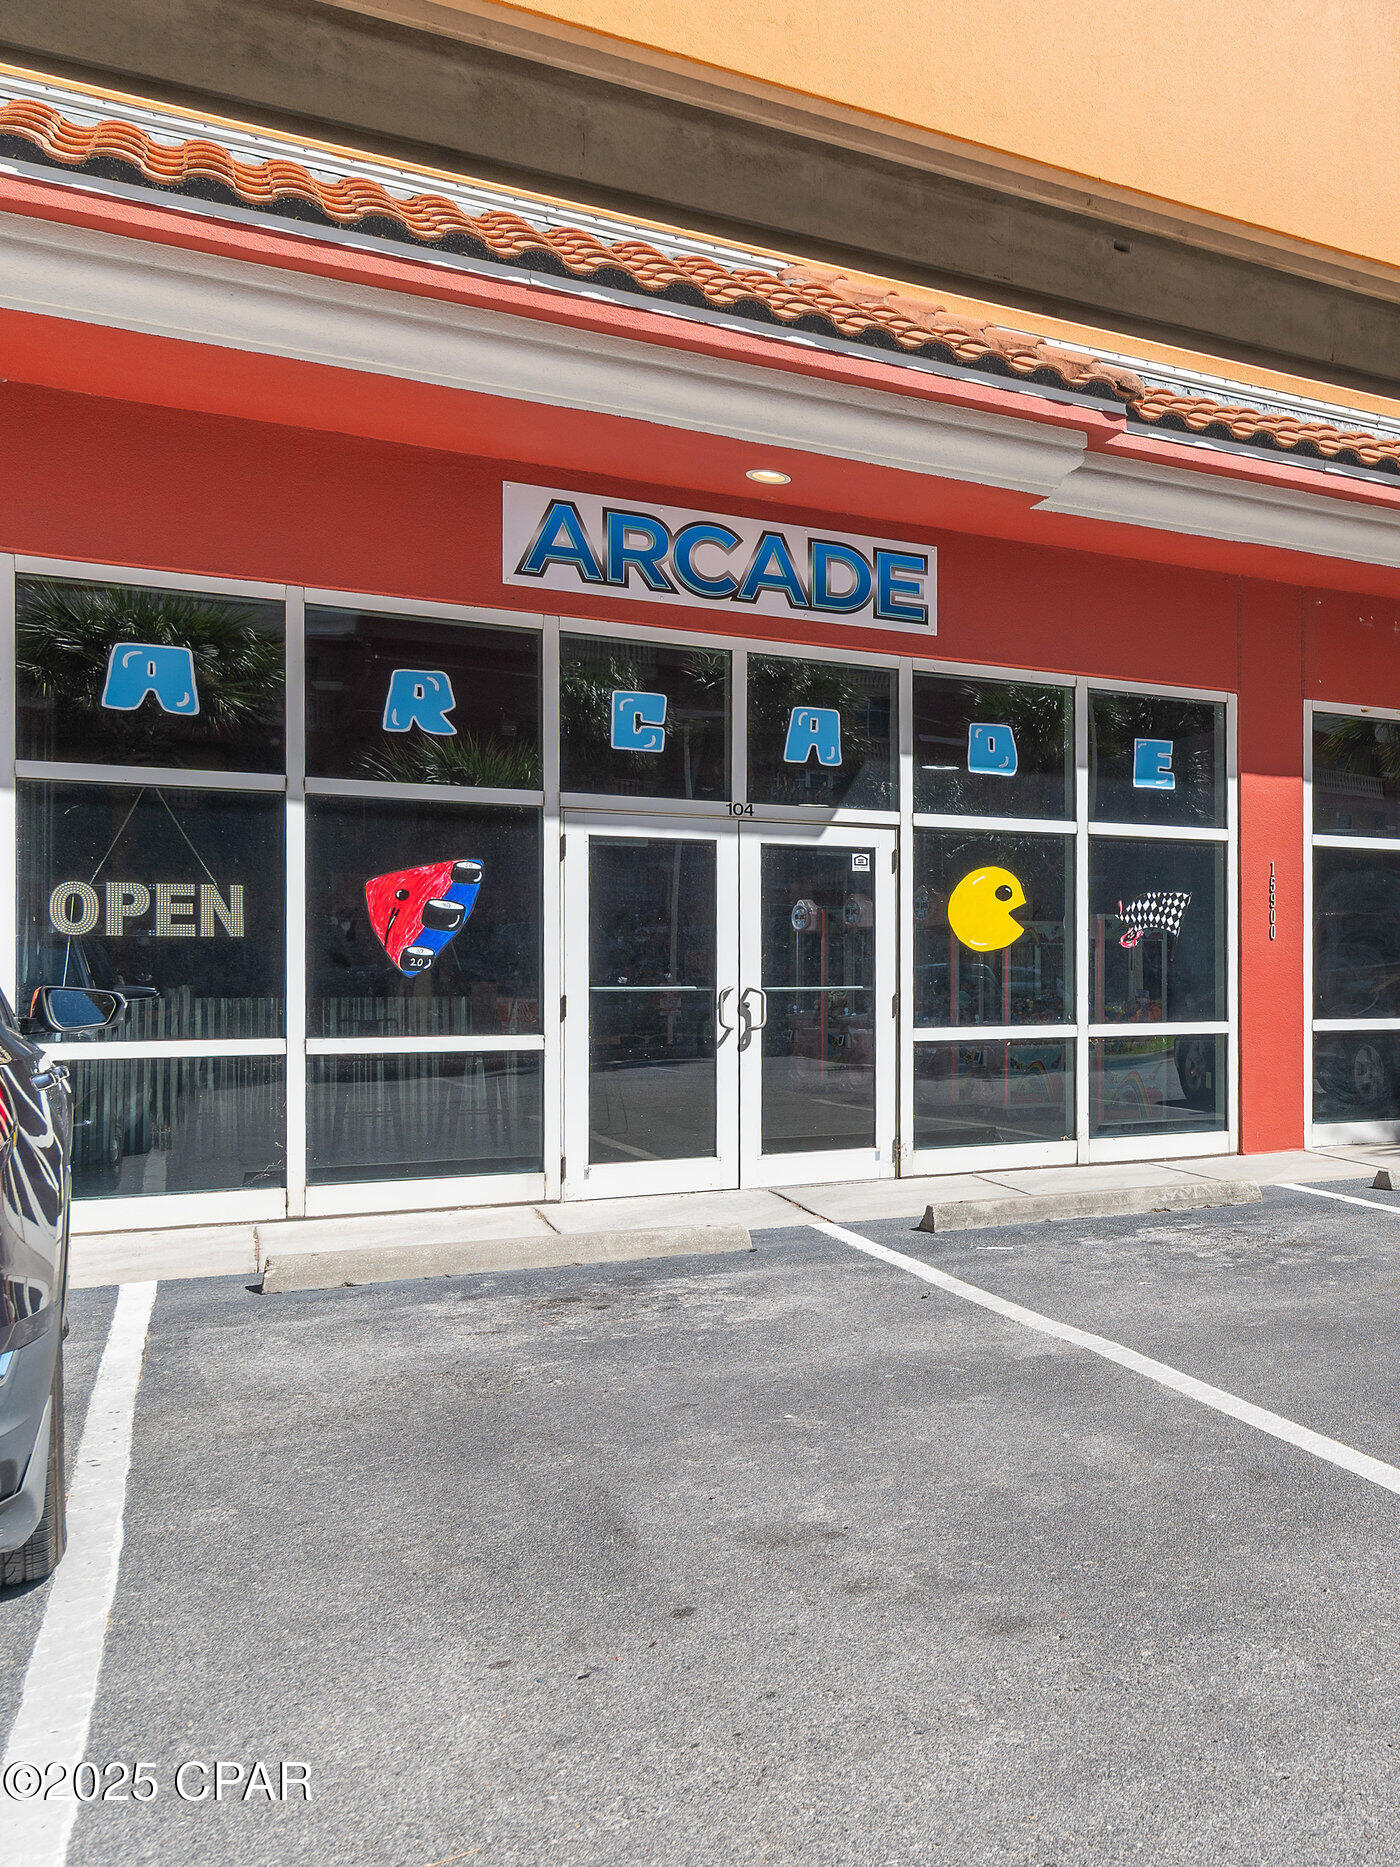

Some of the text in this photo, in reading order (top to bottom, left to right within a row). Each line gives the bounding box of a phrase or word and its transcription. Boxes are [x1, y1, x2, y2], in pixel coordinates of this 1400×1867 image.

[514, 498, 929, 625] ARCADE
[725, 803, 755, 816] 104
[49, 880, 245, 938] OPEN
[1268, 861, 1277, 941] 15900
[409, 957, 424, 967] 20
